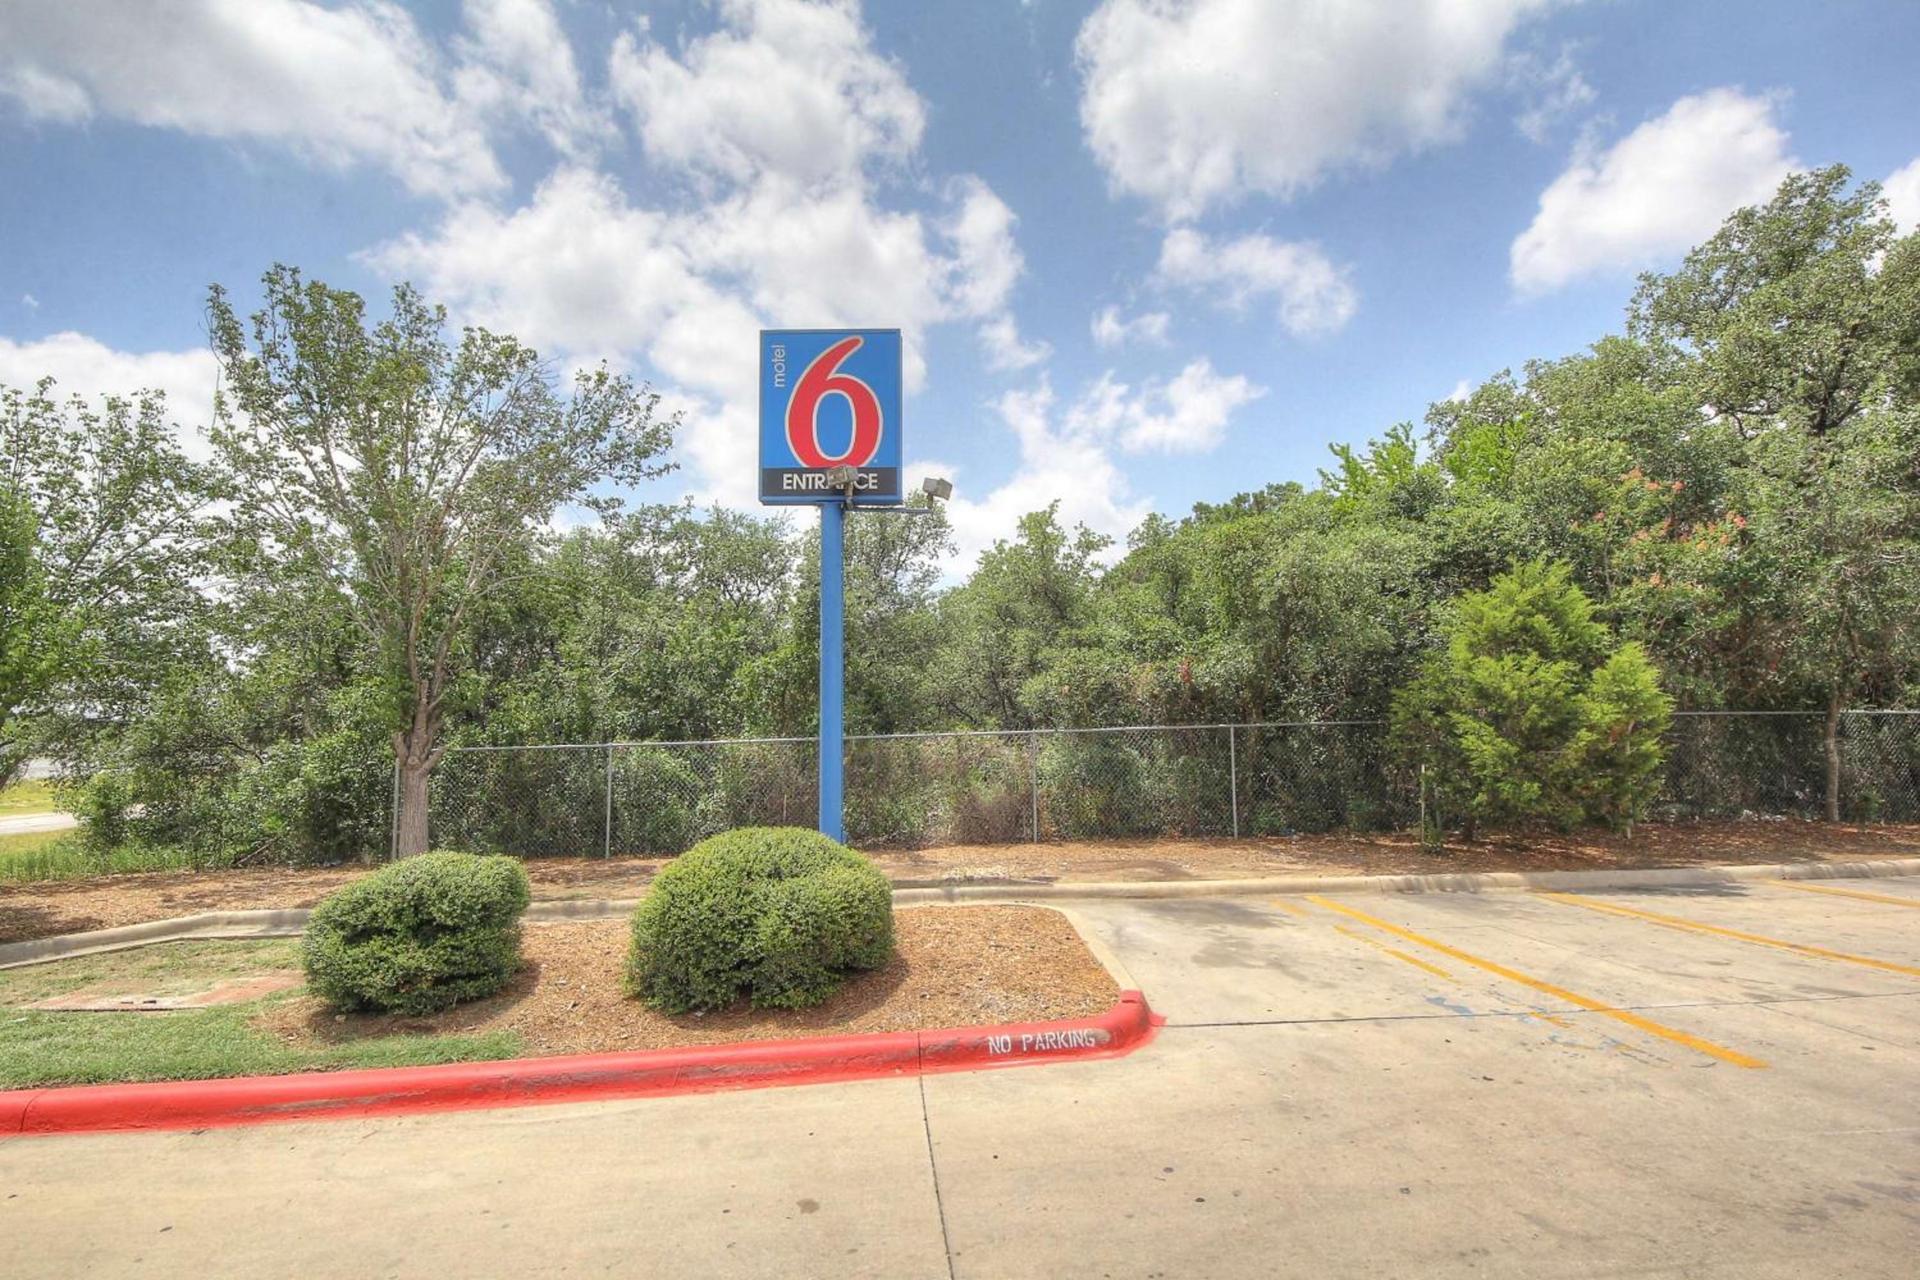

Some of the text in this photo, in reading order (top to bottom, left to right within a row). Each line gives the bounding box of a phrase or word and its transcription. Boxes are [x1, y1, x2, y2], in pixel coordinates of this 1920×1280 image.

[771, 344, 786, 387] motel
[785, 335, 884, 468] 6
[783, 473, 878, 490] ENTRCE
[988, 1028, 1096, 1055] NO PARKING
